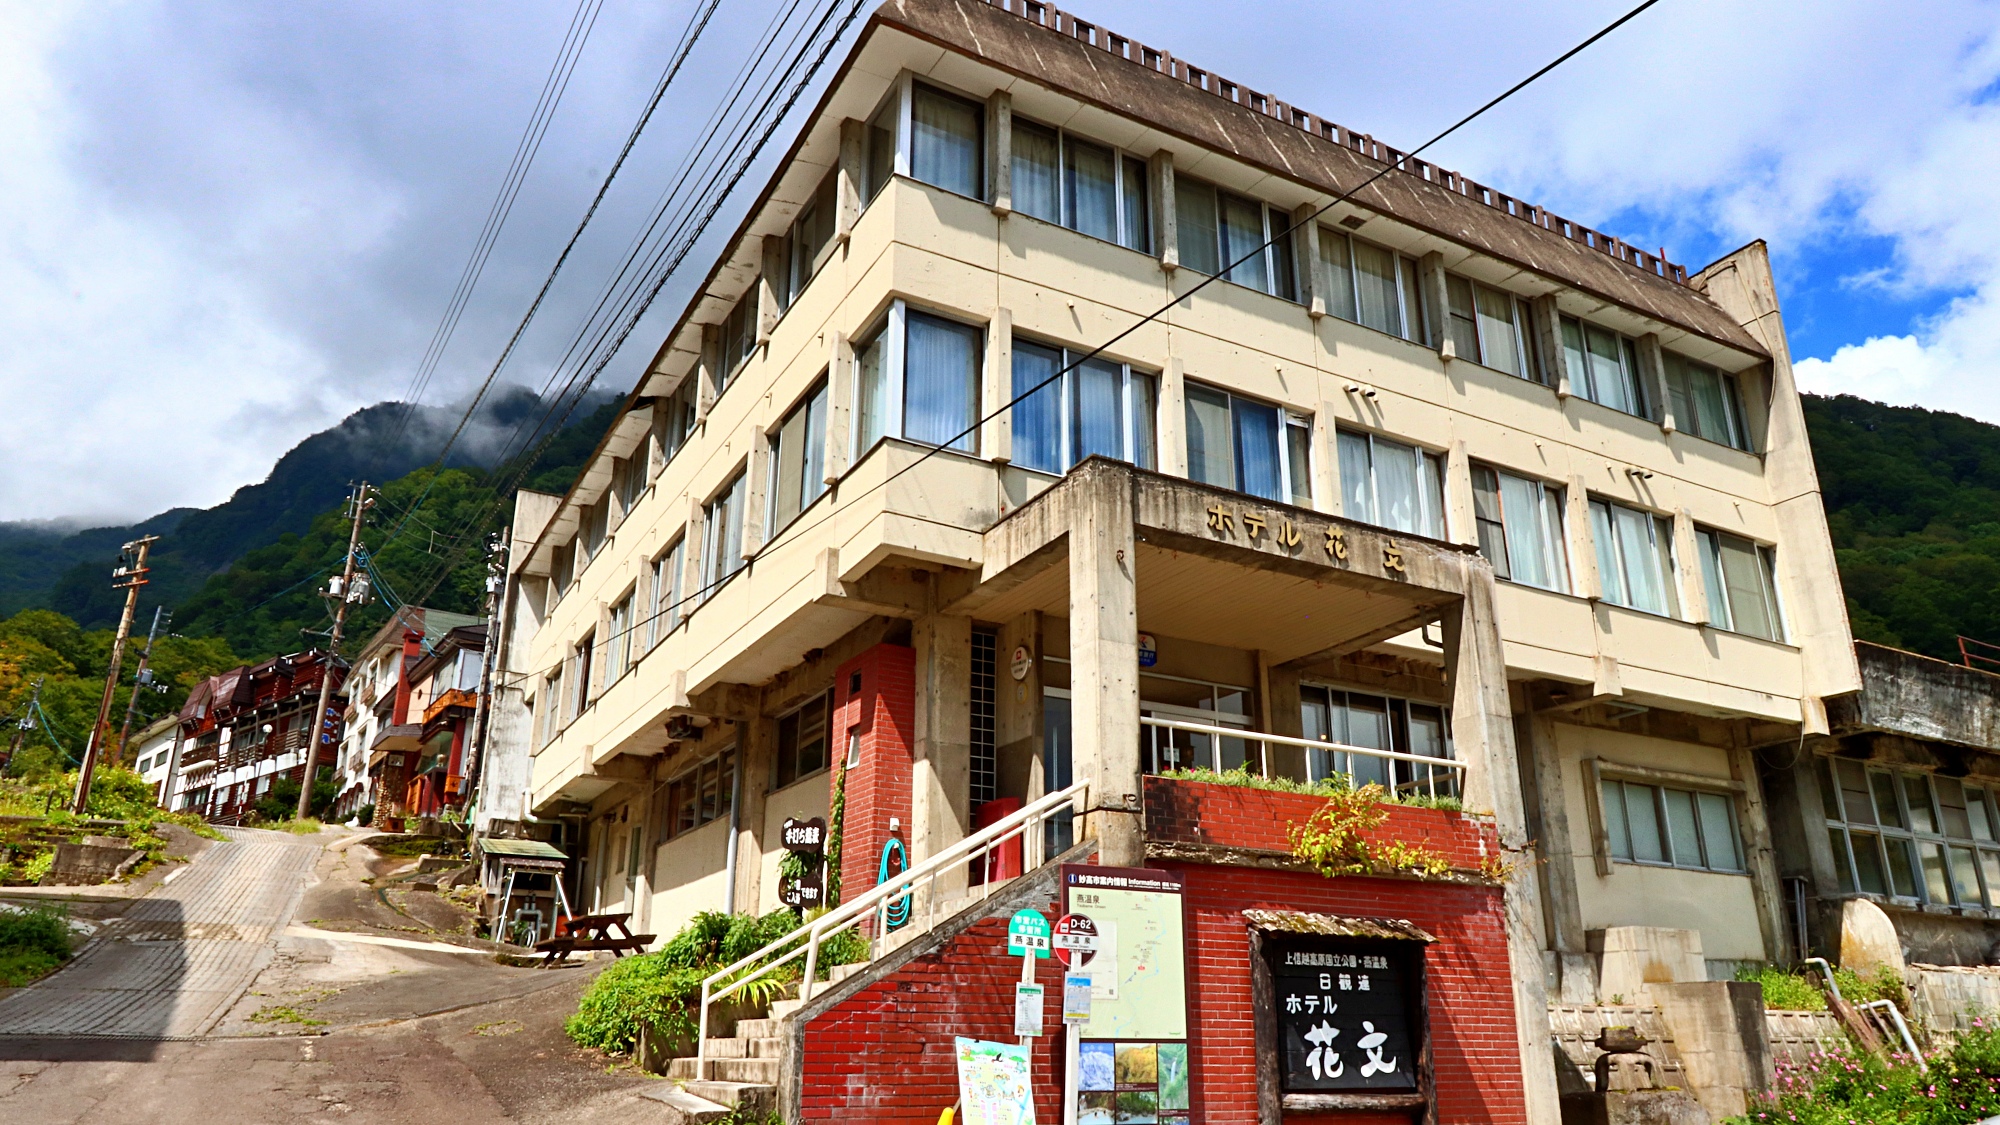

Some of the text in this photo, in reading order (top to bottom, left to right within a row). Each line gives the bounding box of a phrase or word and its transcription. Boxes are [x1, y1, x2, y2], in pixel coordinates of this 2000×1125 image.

[1070, 918, 1092, 929] D-62
[1285, 993, 1338, 1015] ホテル
[1303, 1019, 1397, 1081] 花文
